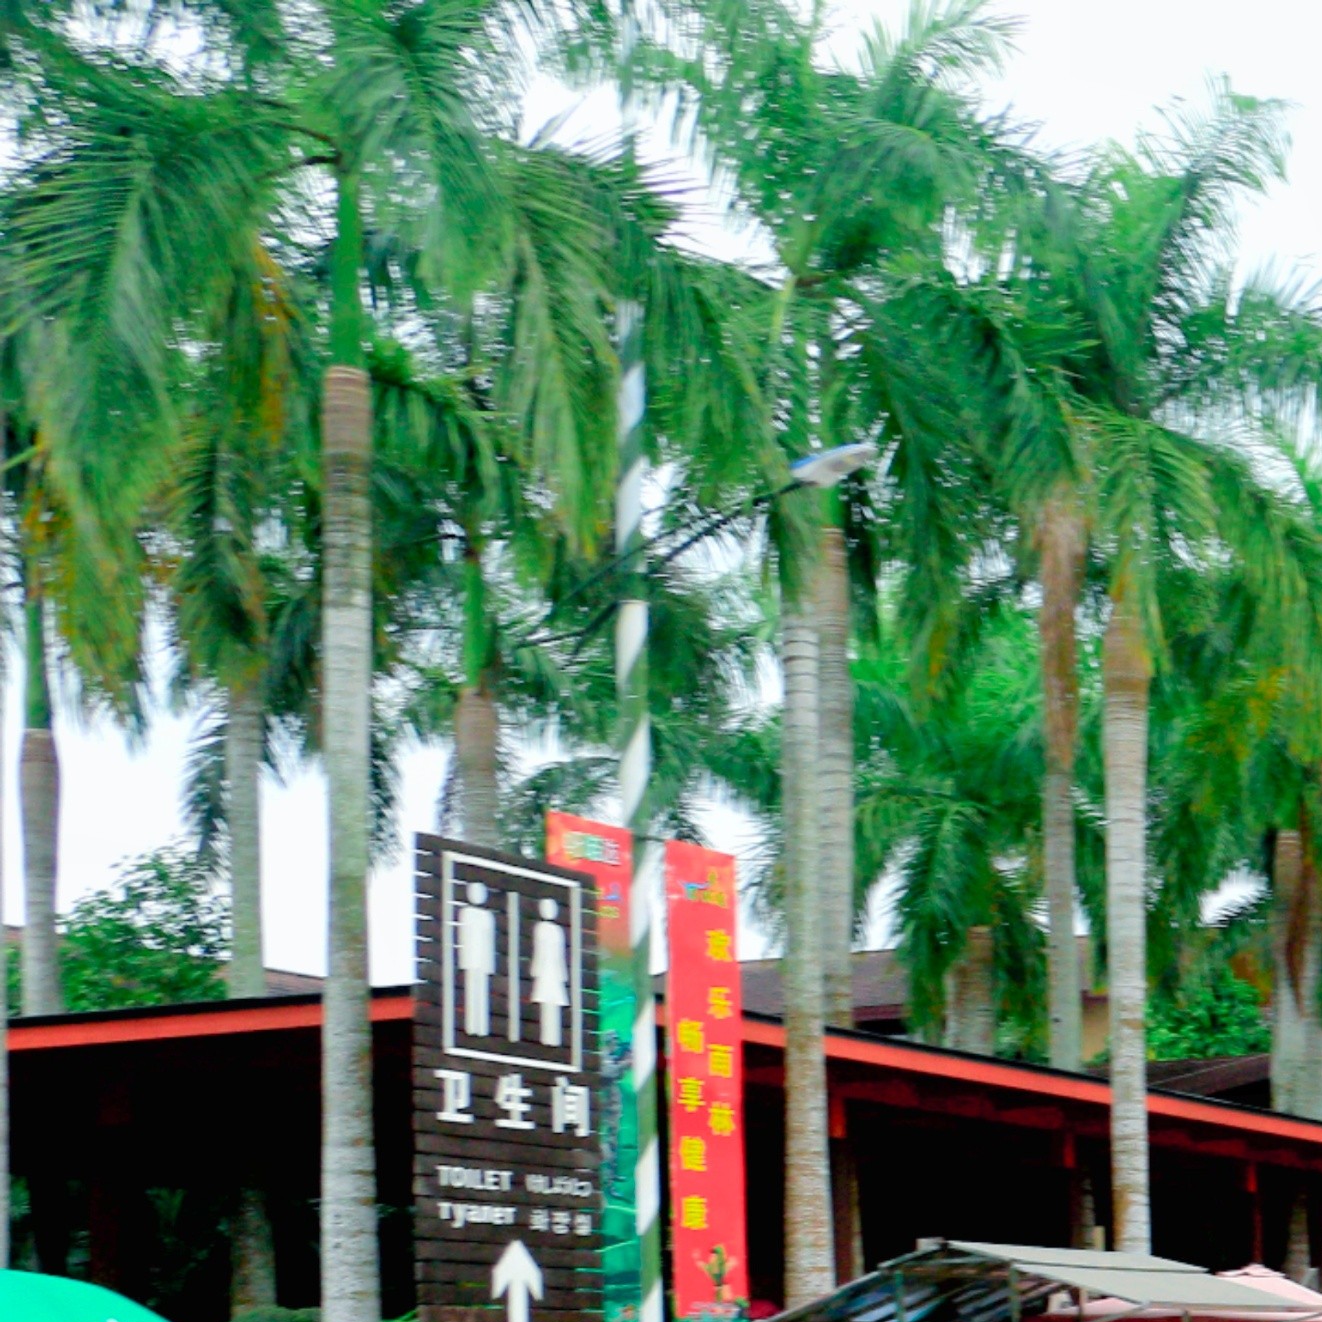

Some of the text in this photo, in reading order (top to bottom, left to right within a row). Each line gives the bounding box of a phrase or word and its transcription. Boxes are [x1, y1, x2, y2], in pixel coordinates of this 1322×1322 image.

[705, 928, 736, 1136] 欢乐雨林
[433, 1069, 591, 1137] 卫生间
[676, 1017, 708, 1230] 畅享健康
[435, 1165, 514, 1192] TOILET
